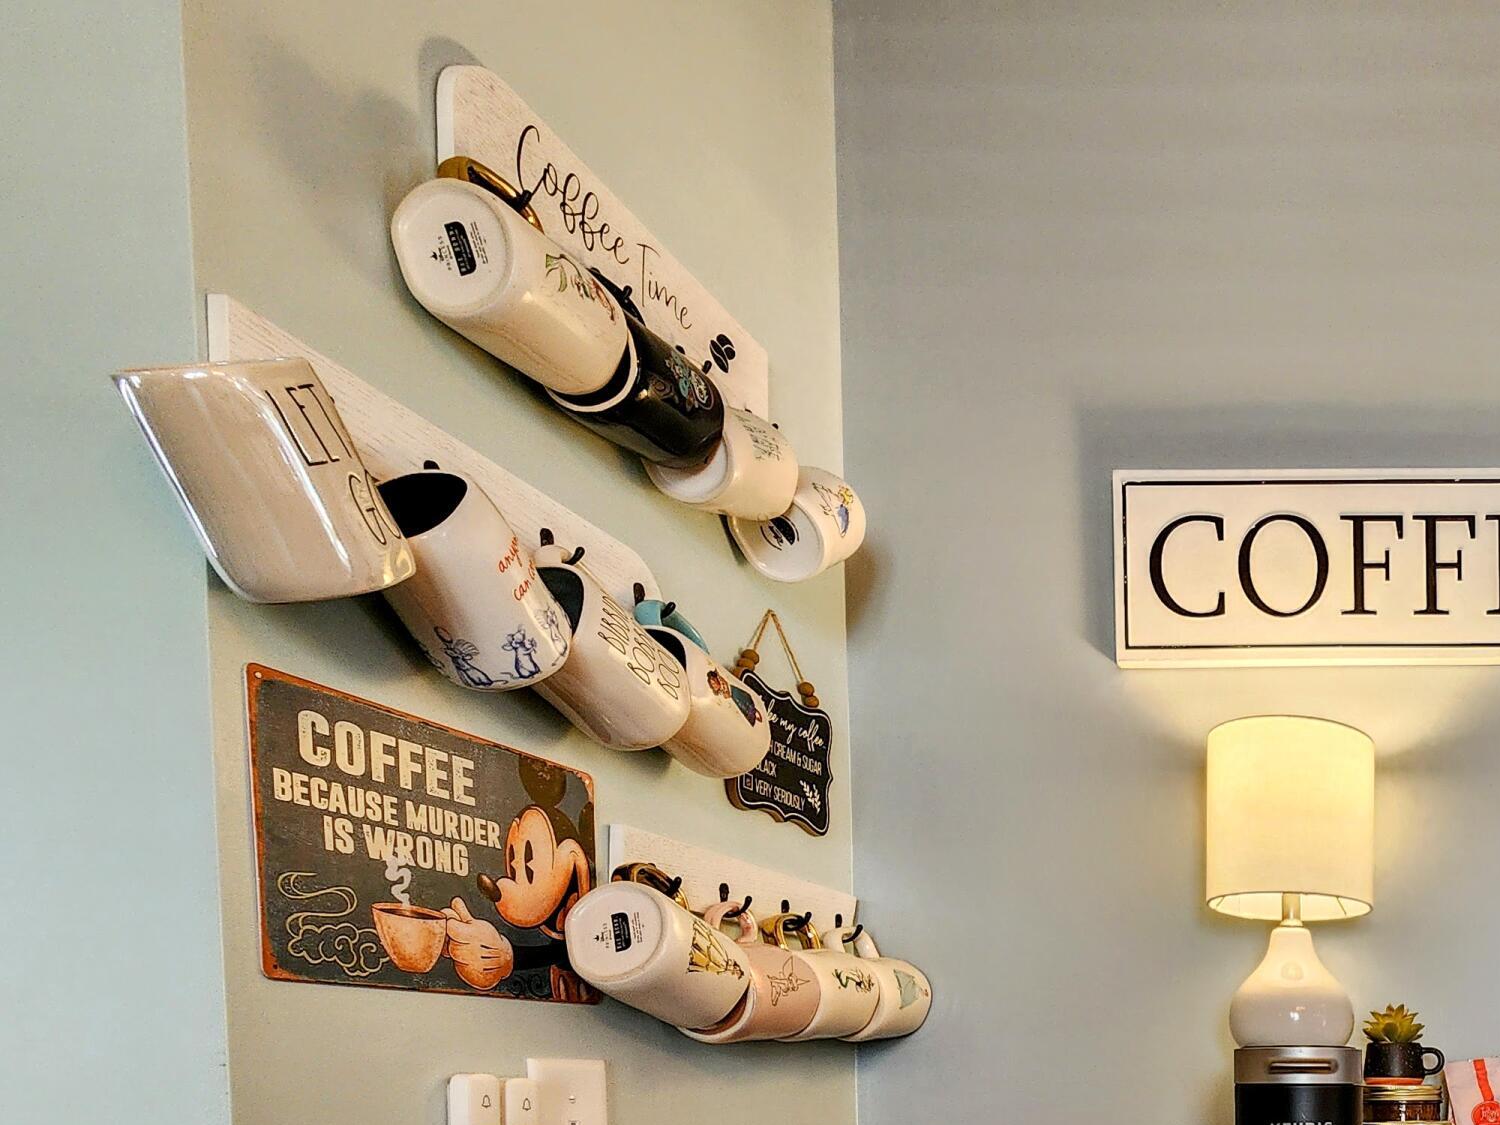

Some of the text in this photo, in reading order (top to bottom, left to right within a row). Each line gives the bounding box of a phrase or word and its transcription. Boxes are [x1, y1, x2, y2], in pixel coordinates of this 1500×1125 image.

[517, 124, 693, 330] Coffee Time
[297, 709, 476, 807] COFFEE
[773, 741, 798, 764] CREAM
[801, 752, 822, 775] SUGAR
[780, 716, 798, 745] my
[272, 767, 502, 850] BECAUSE MURDER
[755, 781, 806, 811] VERY SERIOUSLY
[322, 814, 470, 878] IS WRONG
